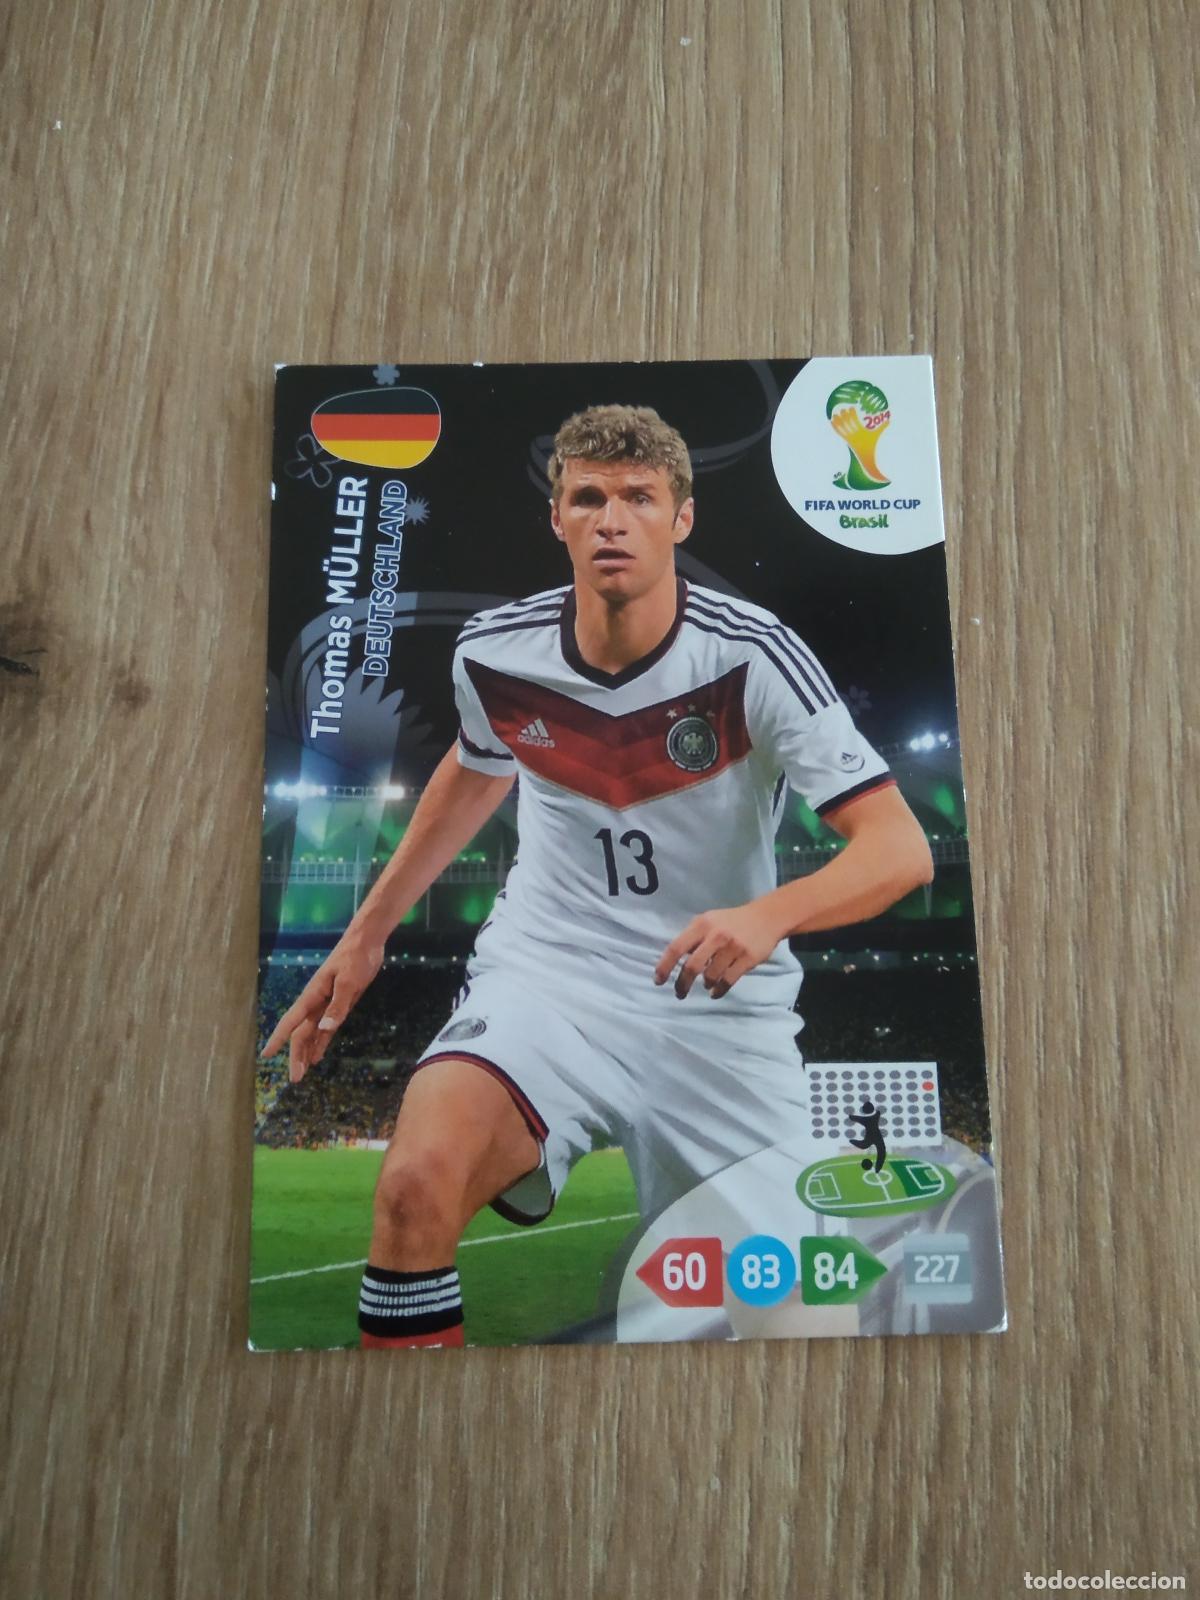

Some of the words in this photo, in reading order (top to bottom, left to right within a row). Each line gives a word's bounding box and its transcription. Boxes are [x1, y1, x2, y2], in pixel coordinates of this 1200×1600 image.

[864, 410, 891, 430] 2014
[804, 500, 836, 511] FIFA
[838, 499, 891, 511] WORLD
[893, 499, 921, 510] CUP
[839, 514, 889, 529] Brasil
[323, 476, 369, 605] MÜLLER
[363, 480, 408, 677] DEUTSCHLAND
[310, 615, 353, 739] Thomas
[517, 734, 555, 748] adidas
[593, 828, 660, 896] 13
[662, 1252, 706, 1291] 60
[741, 1254, 781, 1290] 83
[813, 1252, 859, 1290] 84
[914, 1255, 960, 1283] 227
